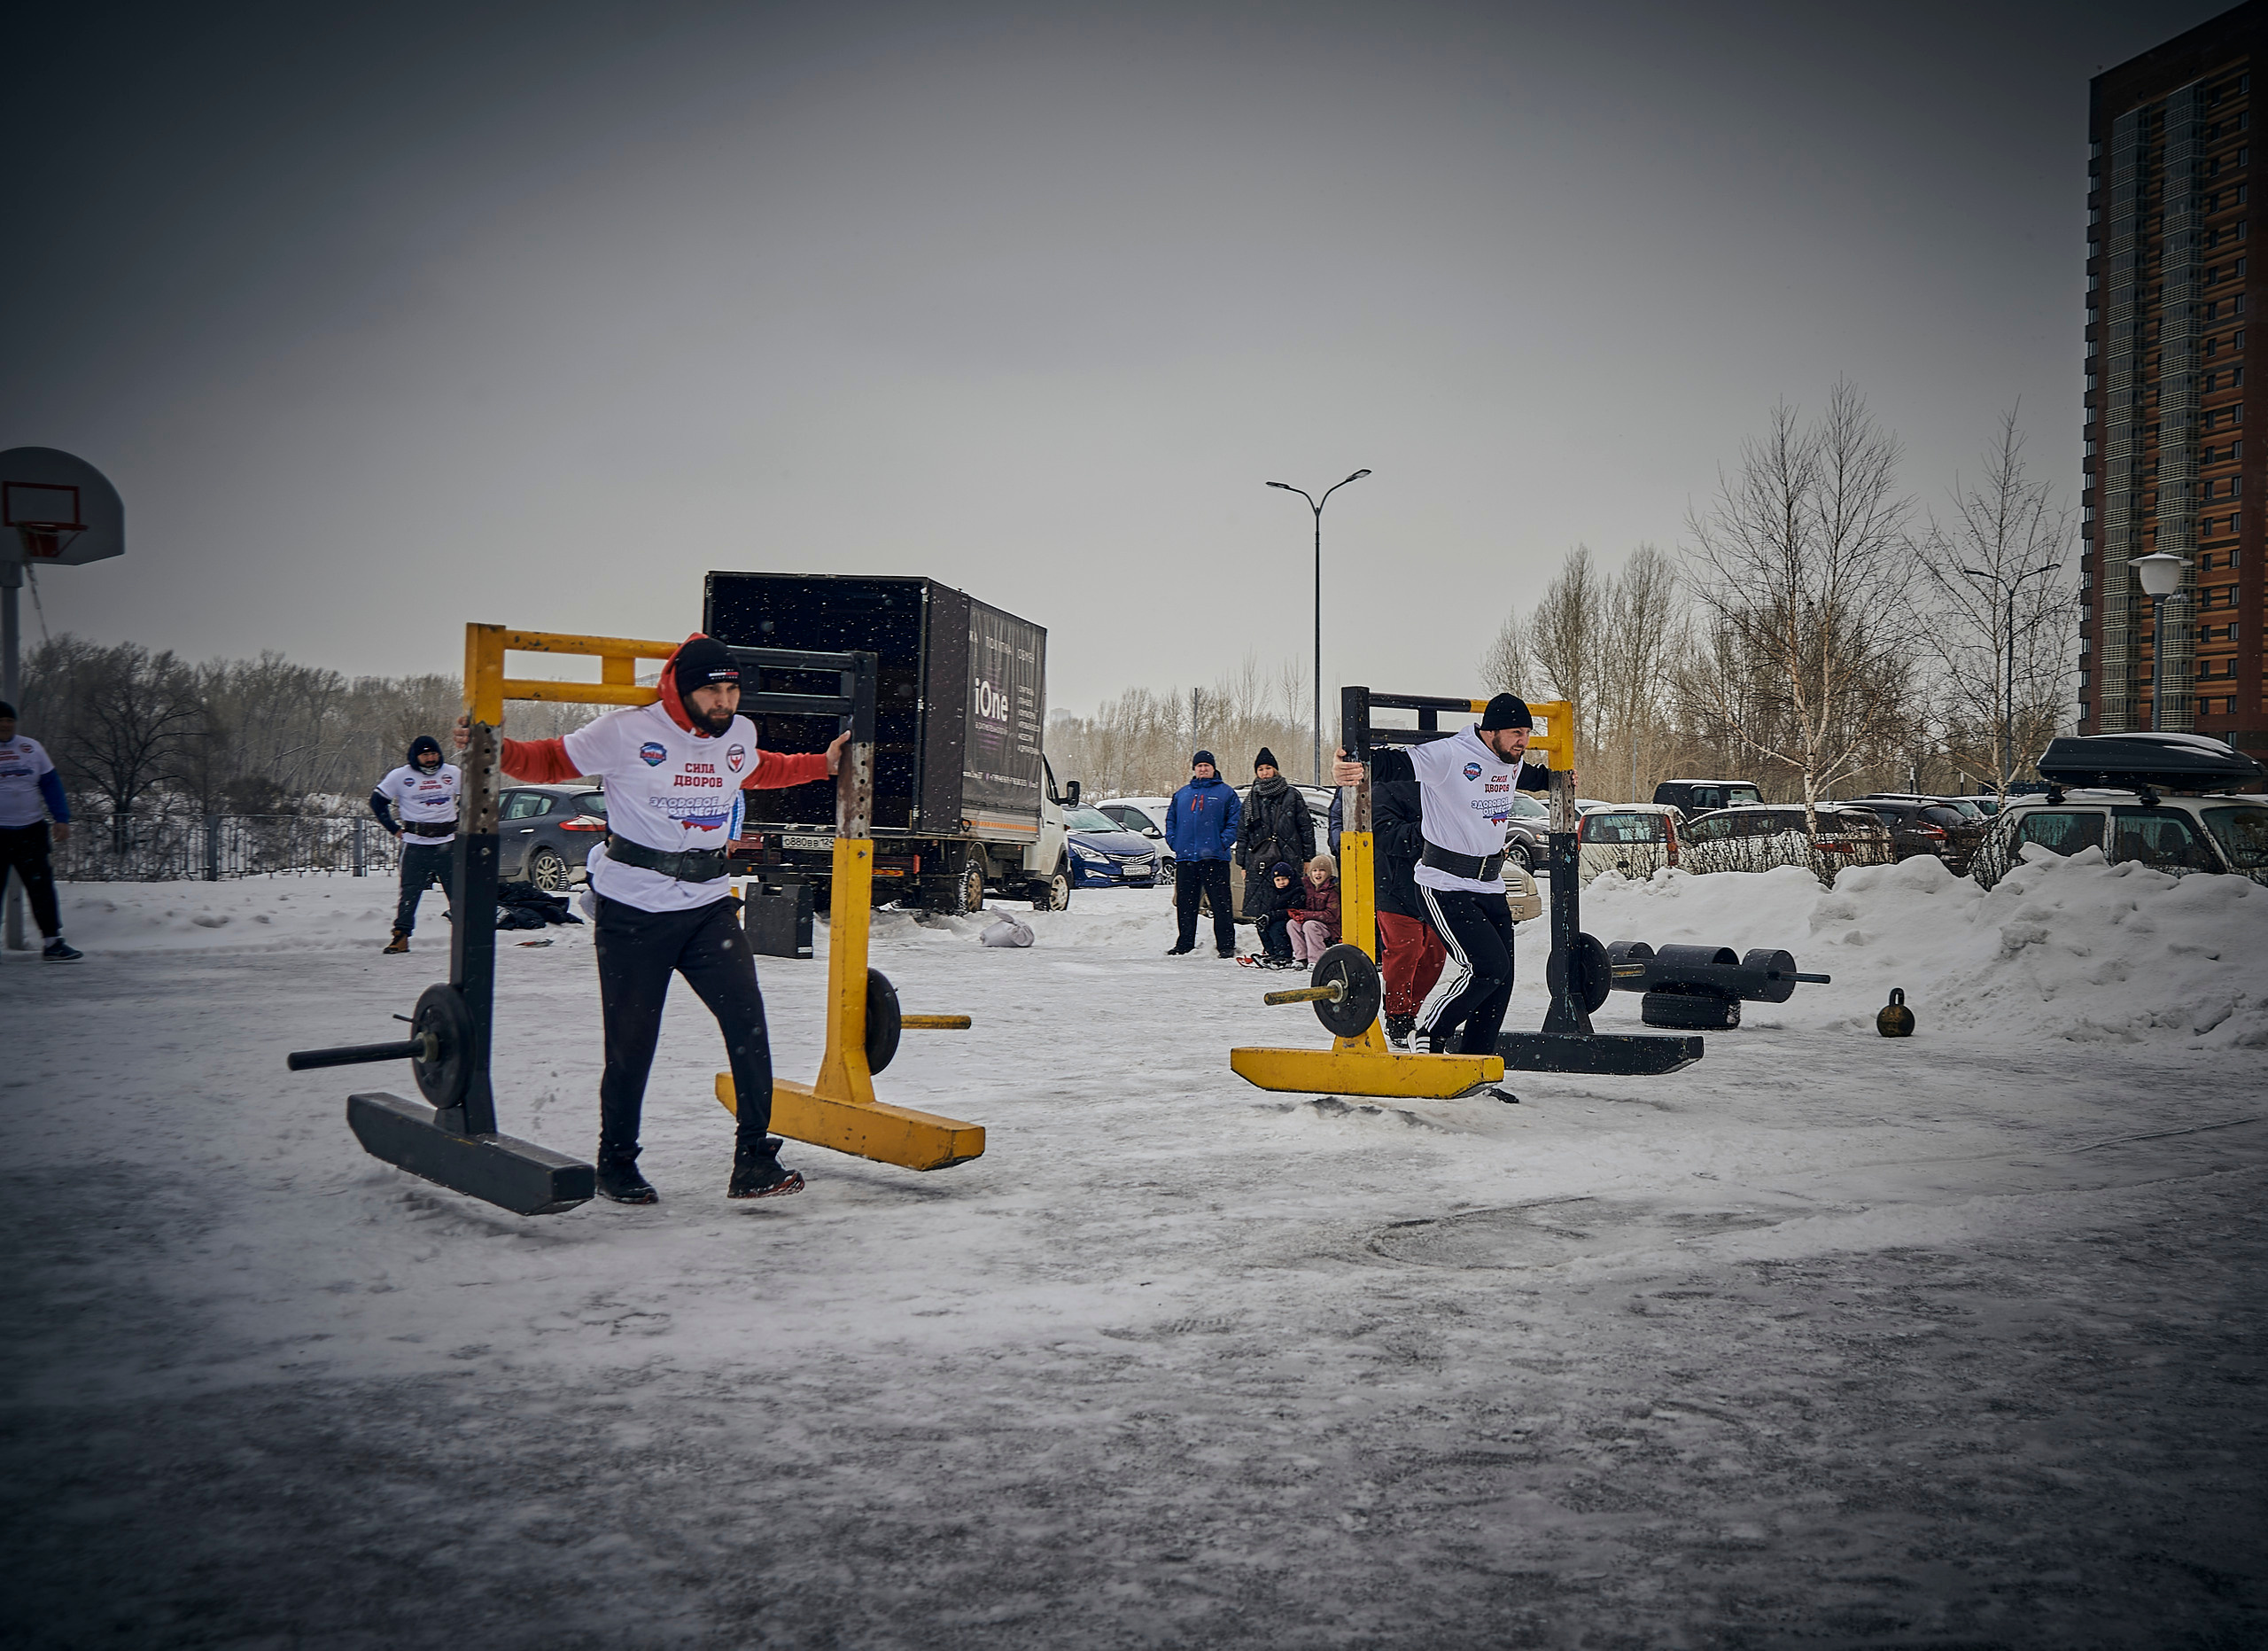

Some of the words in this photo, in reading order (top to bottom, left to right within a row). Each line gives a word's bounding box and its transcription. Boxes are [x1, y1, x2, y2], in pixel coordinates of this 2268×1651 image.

[975, 677, 1009, 721] iOne
[685, 762, 715, 774] СИЛА
[673, 775, 723, 788] ДВОРОВ
[649, 796, 718, 808] ЗДОРОВОЕ
[668, 804, 730, 816] ОТЕЧЕСТВО
